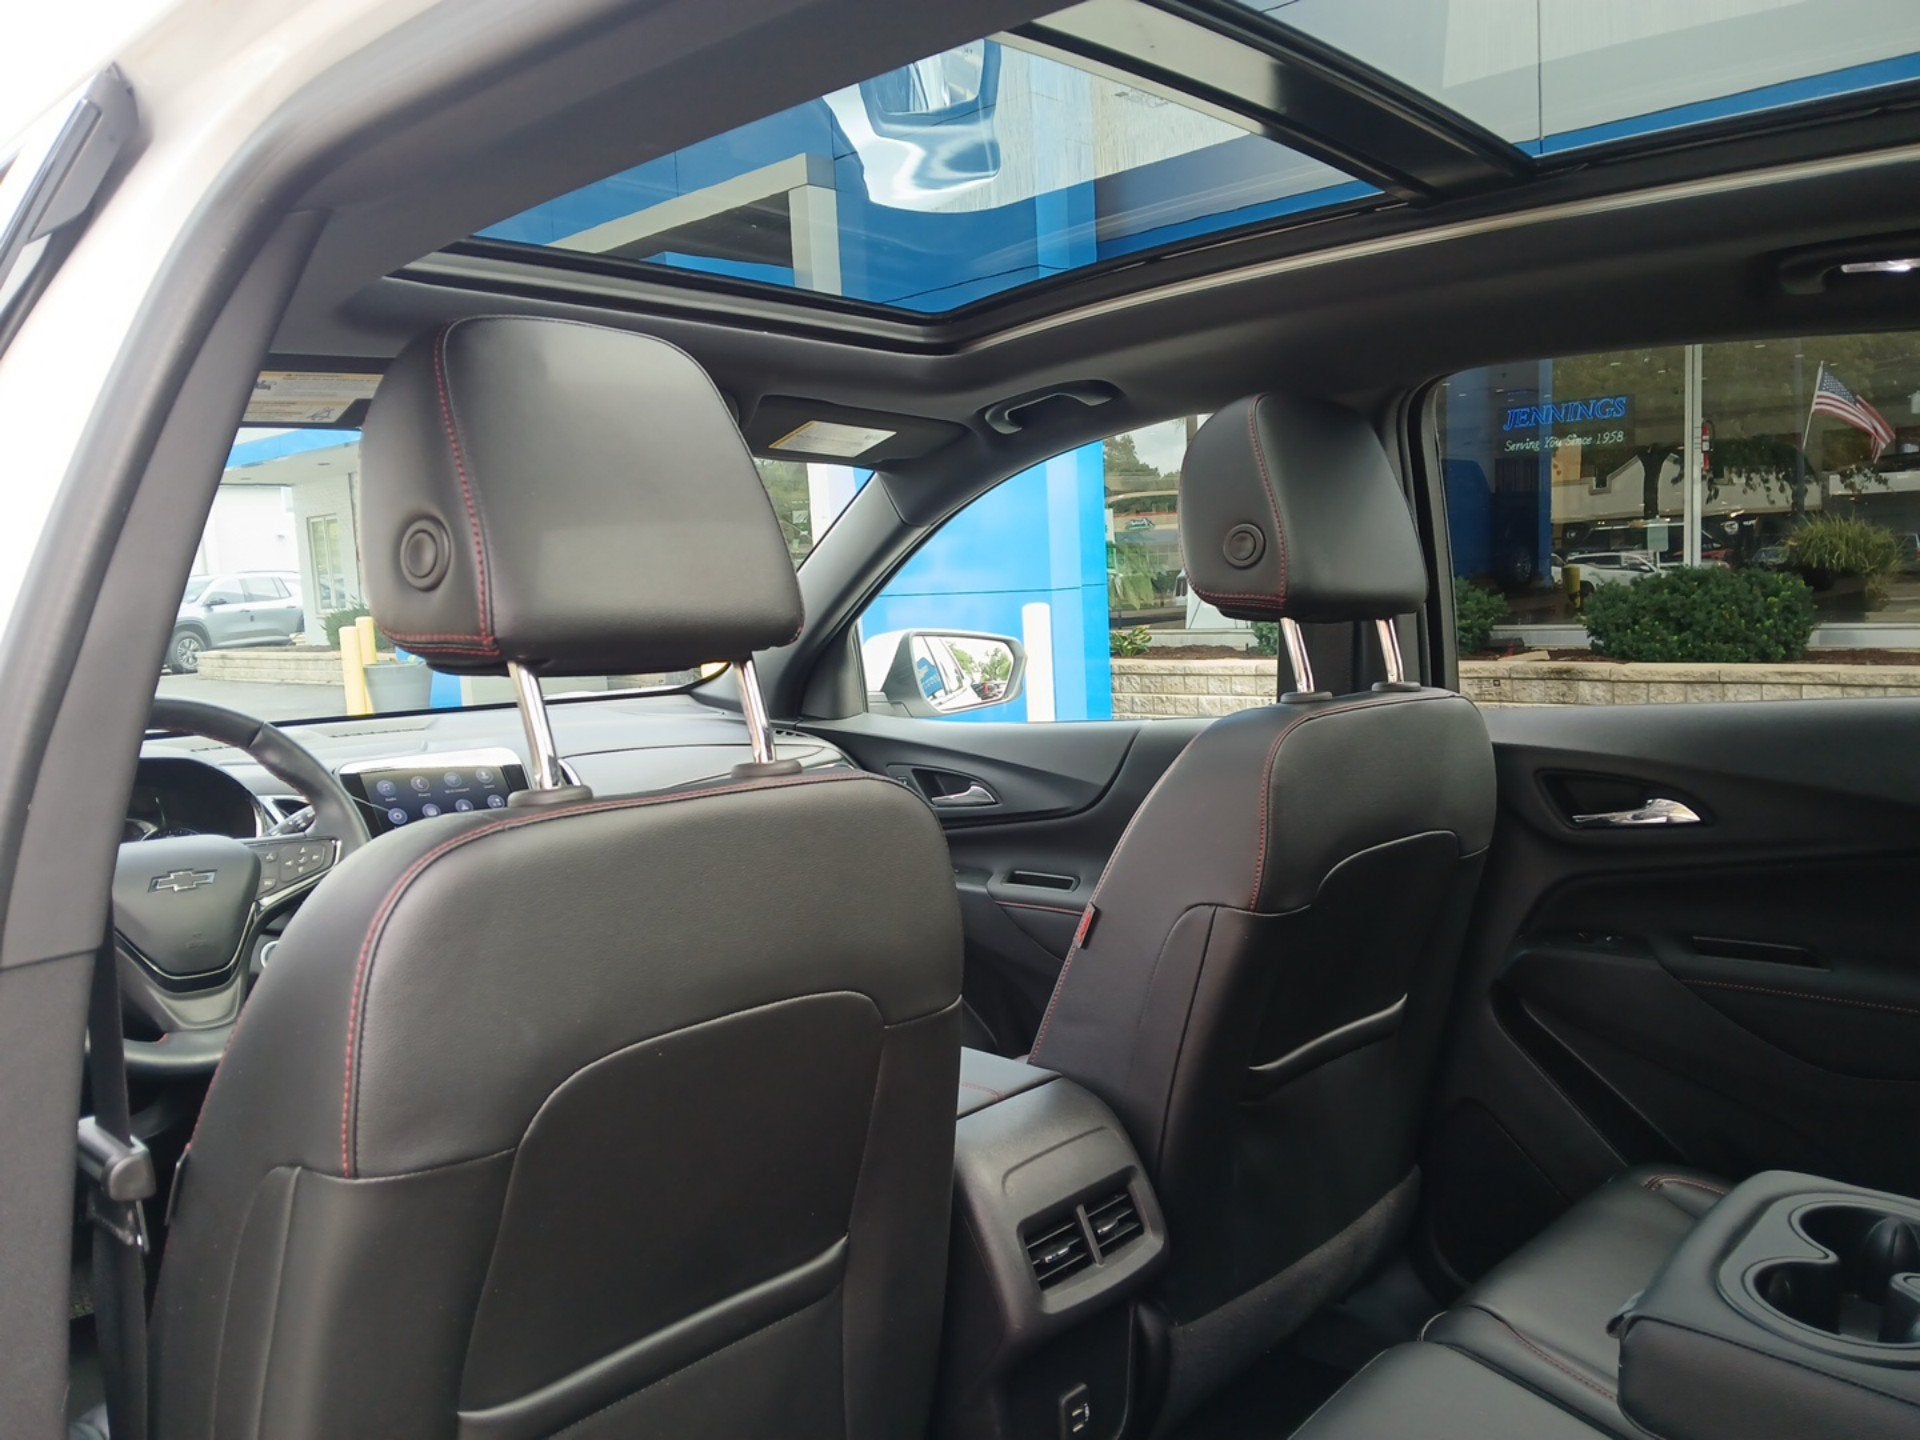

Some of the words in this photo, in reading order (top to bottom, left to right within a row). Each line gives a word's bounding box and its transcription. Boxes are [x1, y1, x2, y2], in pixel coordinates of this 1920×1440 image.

[1503, 397, 1627, 431] JENNINGS
[1505, 438, 1540, 452] Serving
[1544, 436, 1562, 448] You
[1566, 433, 1593, 446] Since
[1597, 430, 1624, 445] 1958
